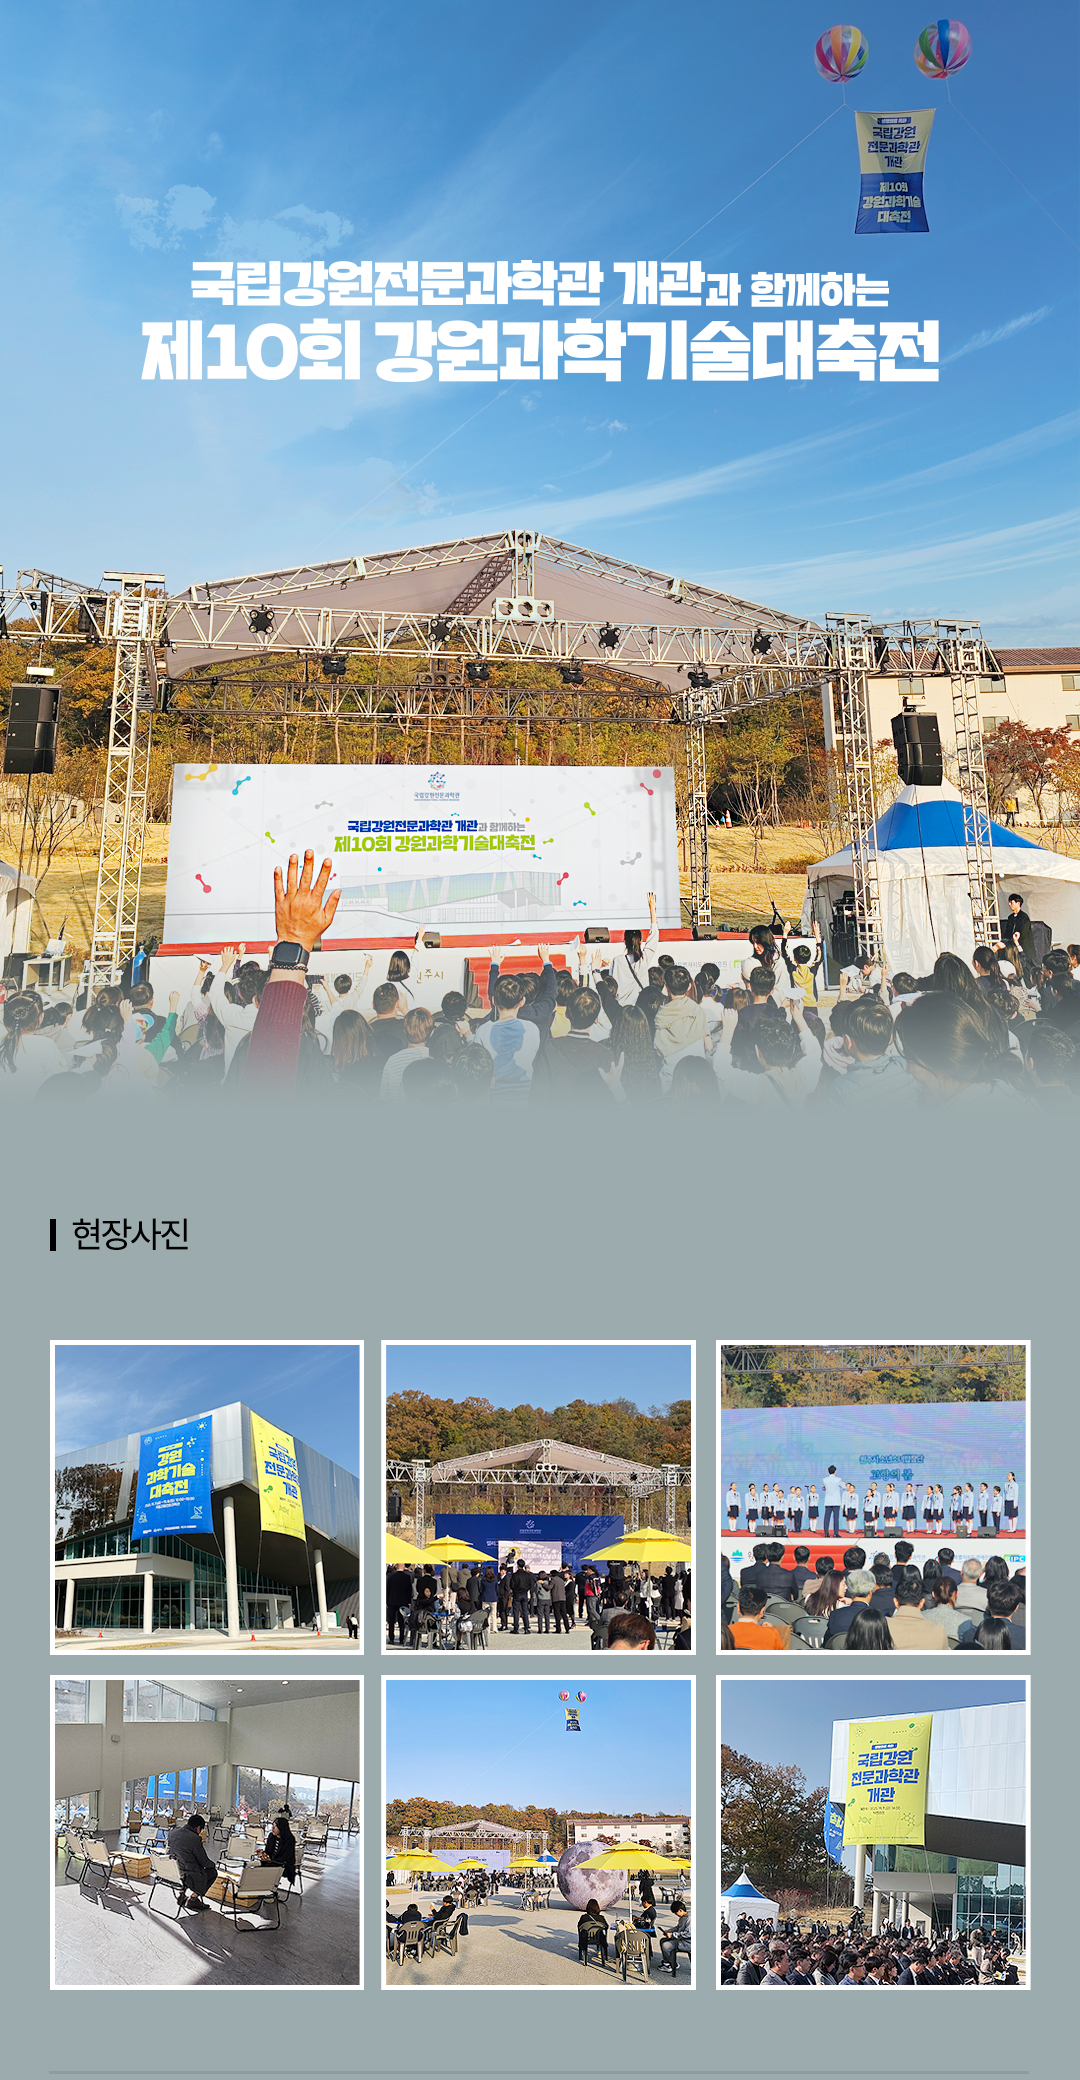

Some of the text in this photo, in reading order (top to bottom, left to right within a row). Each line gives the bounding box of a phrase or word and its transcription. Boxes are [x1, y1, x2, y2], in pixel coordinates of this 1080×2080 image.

[872, 126, 916, 140] 국립강원
[867, 141, 921, 153] 전문과학관
[884, 155, 903, 168] 개관
[879, 182, 908, 192] 제10회
[862, 195, 921, 209] 강원과학기술
[877, 210, 911, 223] 대축전
[347, 820, 526, 832] 국립강원전문과학관 개관과 함께하는
[334, 834, 536, 852] 제10회 강원과학기술대축전
[157, 1449, 183, 1467] 강원
[146, 1462, 196, 1486] 과학기술
[149, 1479, 189, 1500] 대축전
[858, 1750, 914, 1767] 국립강원
[851, 1768, 920, 1787] 전문과학관
[867, 1787, 896, 1803] 개관
